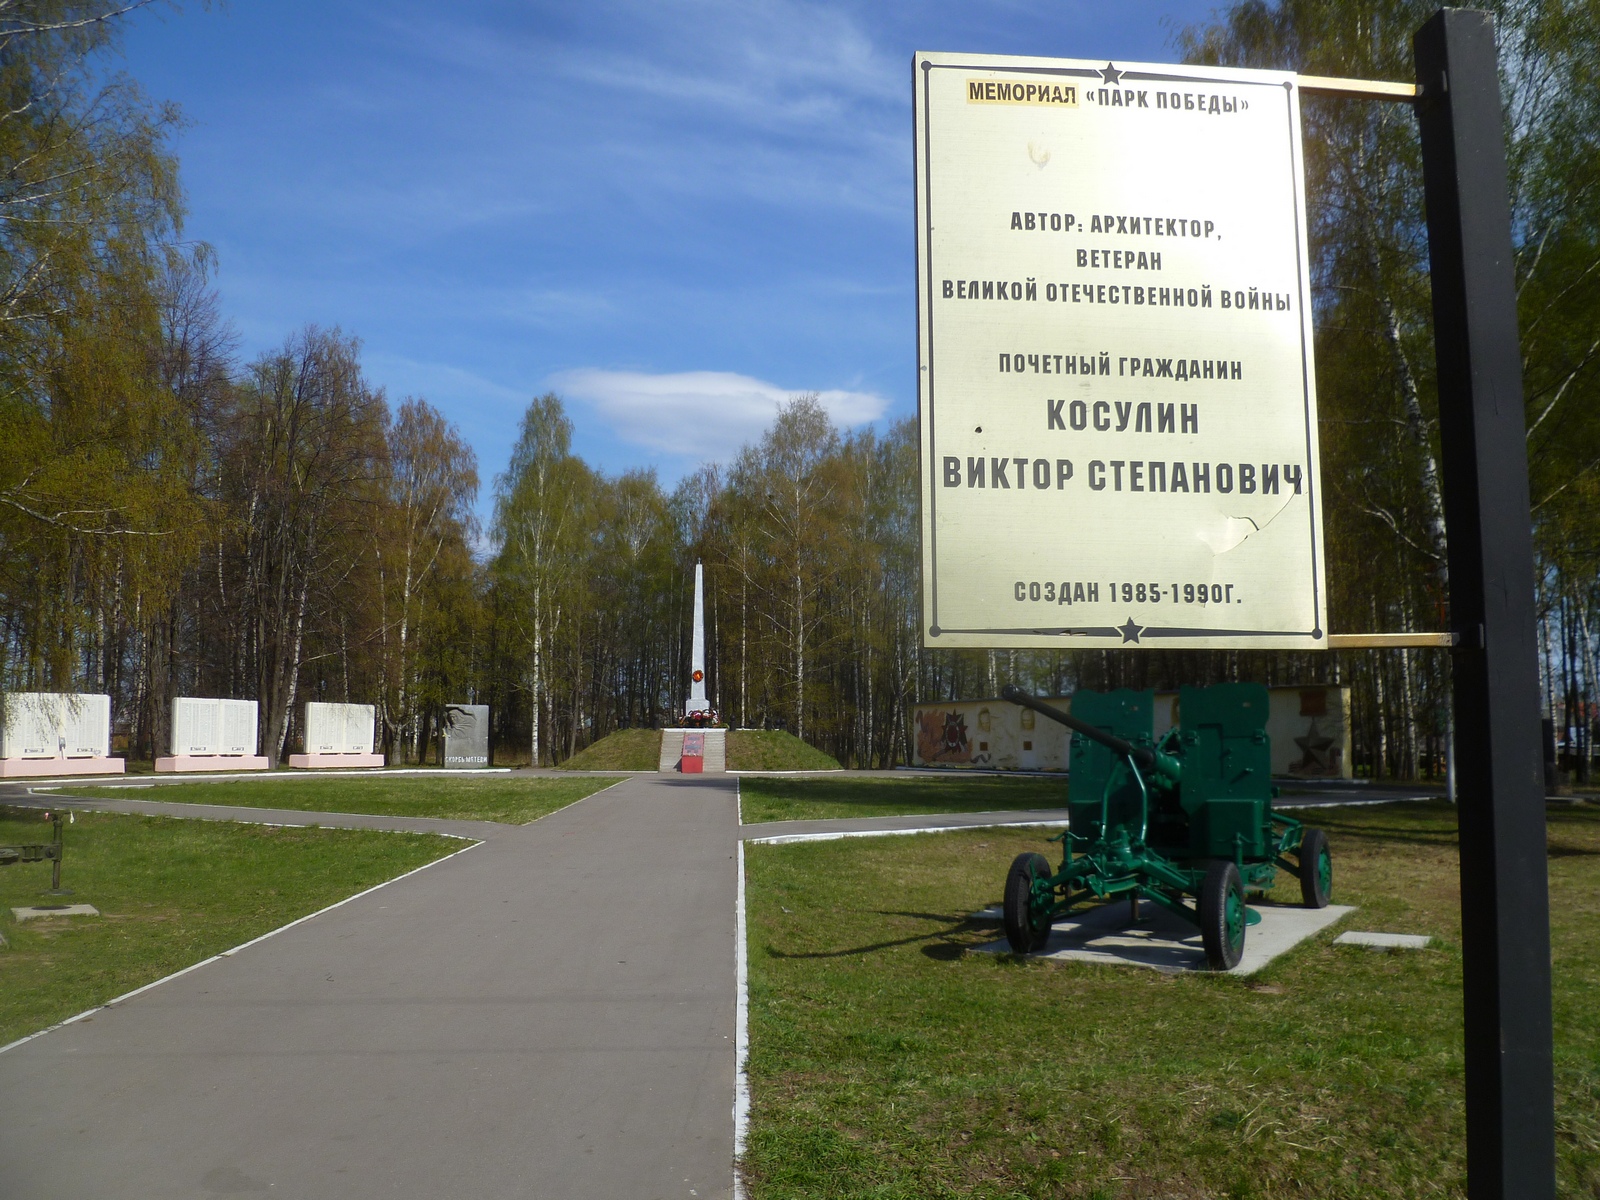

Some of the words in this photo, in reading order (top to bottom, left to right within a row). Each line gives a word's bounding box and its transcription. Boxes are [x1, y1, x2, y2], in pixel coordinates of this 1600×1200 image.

[970, 82, 1075, 104] МЕМОРИАЛ
[1087, 89, 1148, 107] «ПАРК
[1157, 92, 1248, 114] ПОБЕДЫ»
[1011, 212, 1082, 232] АВТОР:
[1091, 215, 1221, 240] АРХИТЕКТОР,
[1077, 249, 1161, 270] ВЕТЕРАН
[943, 277, 1036, 301] ВЕЛИКОЙ
[1046, 283, 1211, 308] ОТЕЧЕСТВЕННОЙ
[1221, 287, 1290, 311] ВОЙНЫ
[999, 352, 1110, 375] ПОЧЕТНЫЙ
[1119, 357, 1241, 381] ГРАЖДАНИН
[1048, 400, 1198, 434] КОСУЛИН
[943, 456, 1073, 490] ВИКТОР
[1088, 460, 1302, 495] СТЕПАНОВИЧ
[1015, 582, 1098, 605] СОЗДАН
